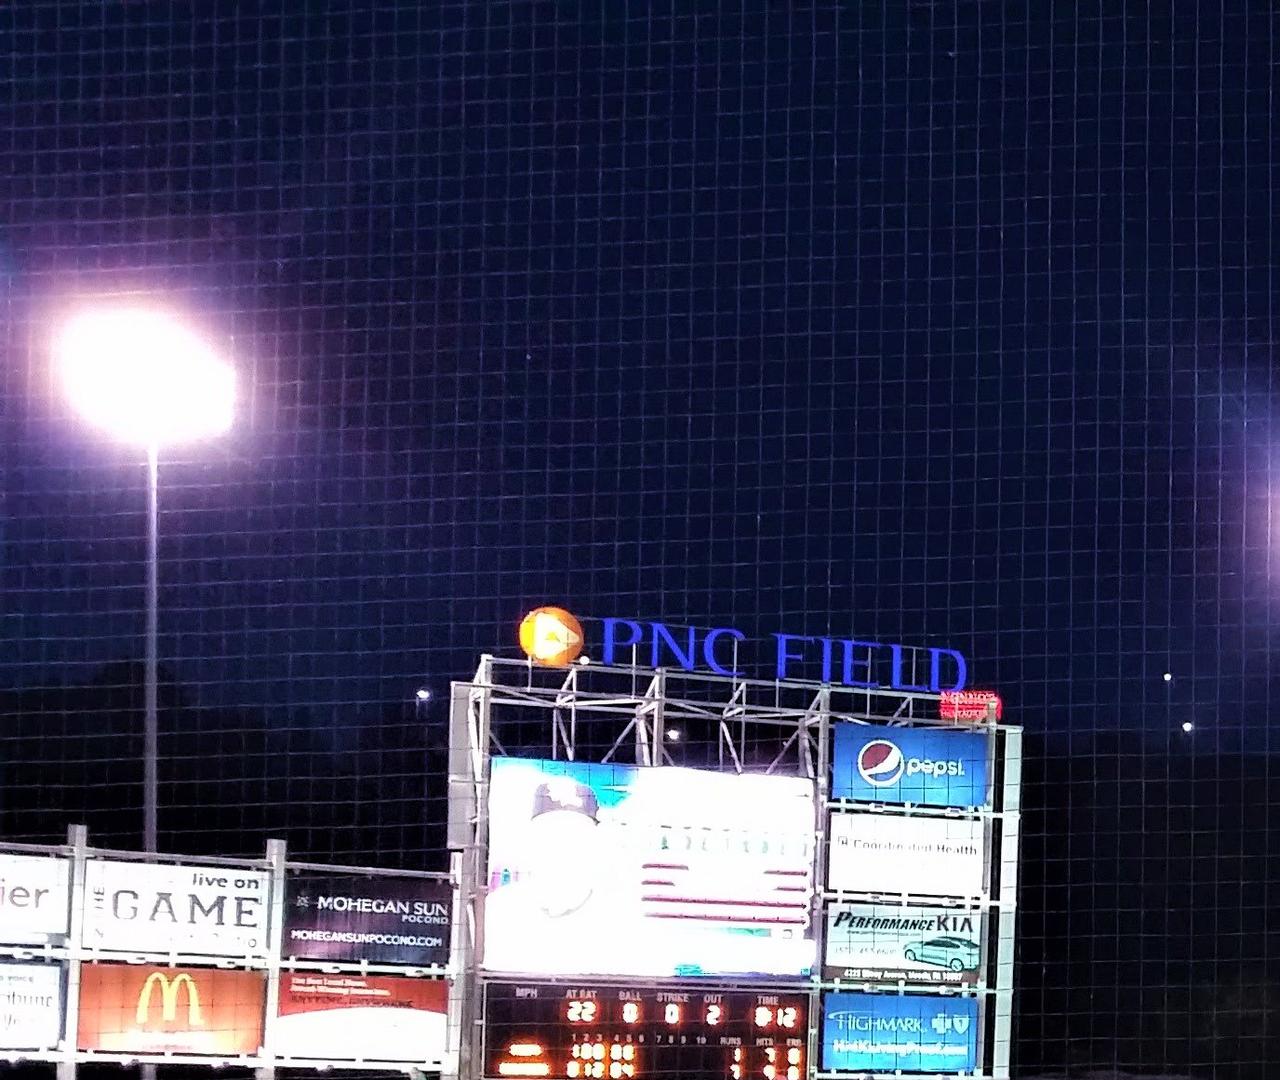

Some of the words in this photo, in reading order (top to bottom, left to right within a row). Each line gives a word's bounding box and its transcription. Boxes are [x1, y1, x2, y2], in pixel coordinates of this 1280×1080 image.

[601, 617, 746, 676] PNC
[771, 633, 966, 692] FIELD
[193, 873, 228, 888] live
[234, 878, 259, 889] on
[112, 889, 262, 928] GAME
[317, 896, 409, 914] MOHEGAN
[413, 901, 449, 916] SUN
[402, 915, 449, 925] POCONO
[834, 911, 935, 931] PERFORMANCE
[936, 915, 974, 933] KIA
[290, 929, 443, 947] MOHEGANSUNPOCONO.COM
[515, 988, 538, 998] MPH
[566, 989, 578, 999] AT
[579, 990, 597, 999] BAT
[618, 991, 641, 1001] BALL
[656, 993, 689, 1003] STRIKE
[703, 994, 724, 1004] OUT
[757, 995, 779, 1005] TIME
[566, 1001, 597, 1022] 22
[706, 1005, 721, 1025] 2
